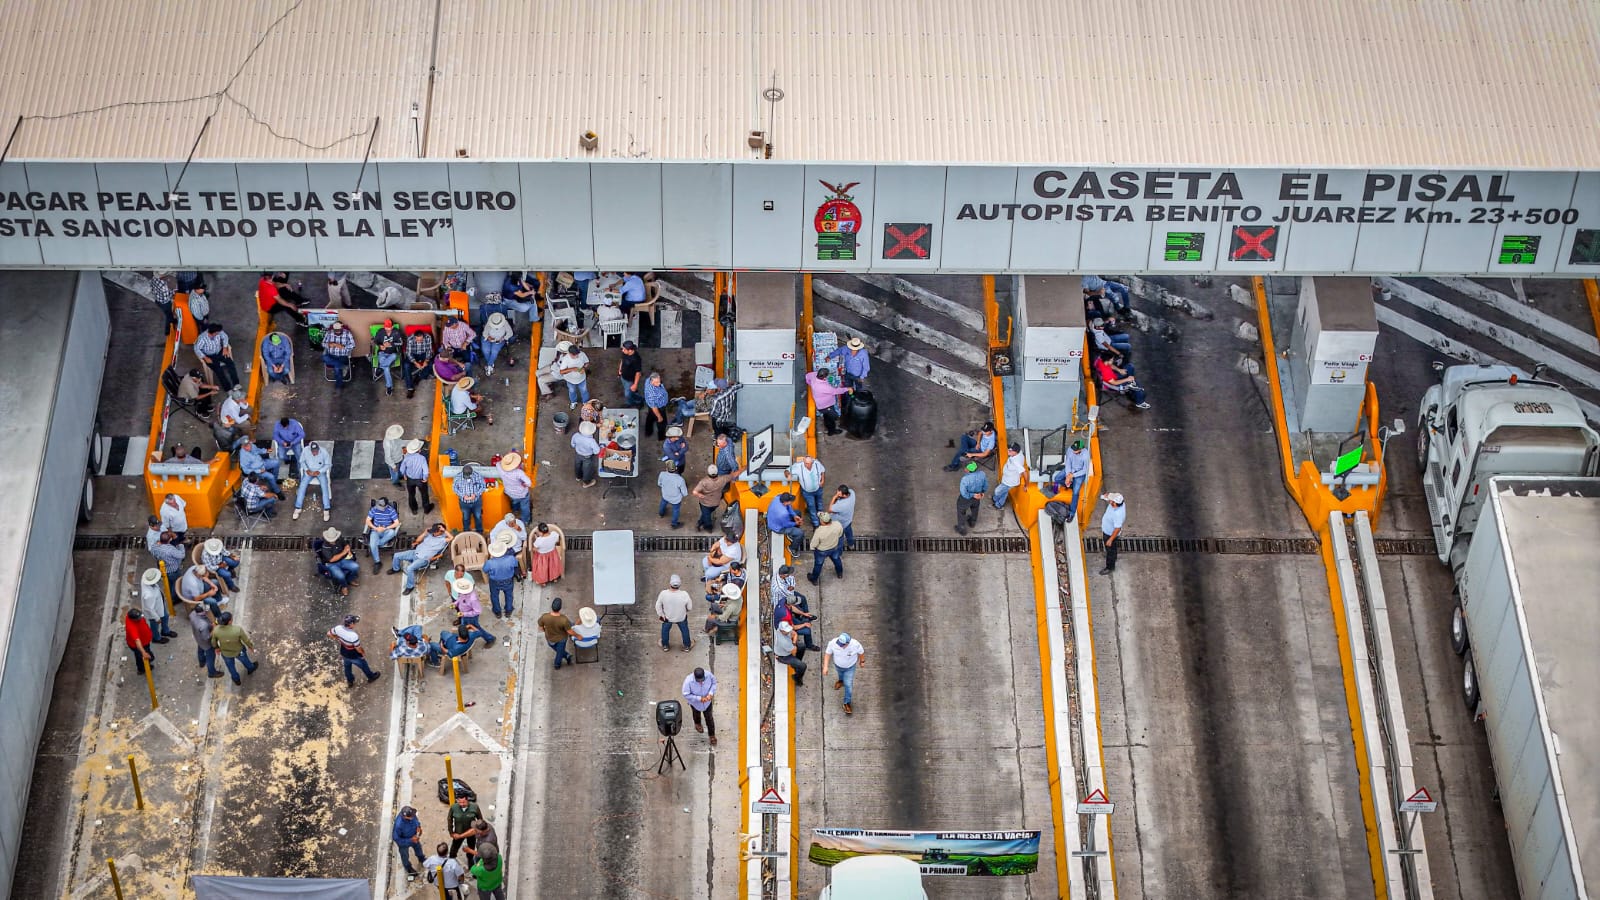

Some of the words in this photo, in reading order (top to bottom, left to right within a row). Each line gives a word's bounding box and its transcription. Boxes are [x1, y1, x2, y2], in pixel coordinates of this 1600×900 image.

[1034, 171, 1243, 199] CASETA
[1279, 174, 1342, 201] EL
[1363, 174, 1514, 203] PISAL
[97, 191, 191, 211] PEAJE
[199, 191, 237, 211] TE
[247, 191, 324, 211] DEJA
[333, 191, 382, 211] SIN
[394, 191, 516, 211] SEGURO
[957, 204, 1134, 221] AUTOPISTA
[1146, 206, 1262, 222] BENITO
[1273, 207, 1396, 223] JUAREZ
[1405, 207, 1462, 224] Km.
[1469, 207, 1580, 225] 23+500
[62, 218, 257, 238] SANCIONADO
[268, 219, 328, 238] POR
[338, 219, 374, 237] LA
